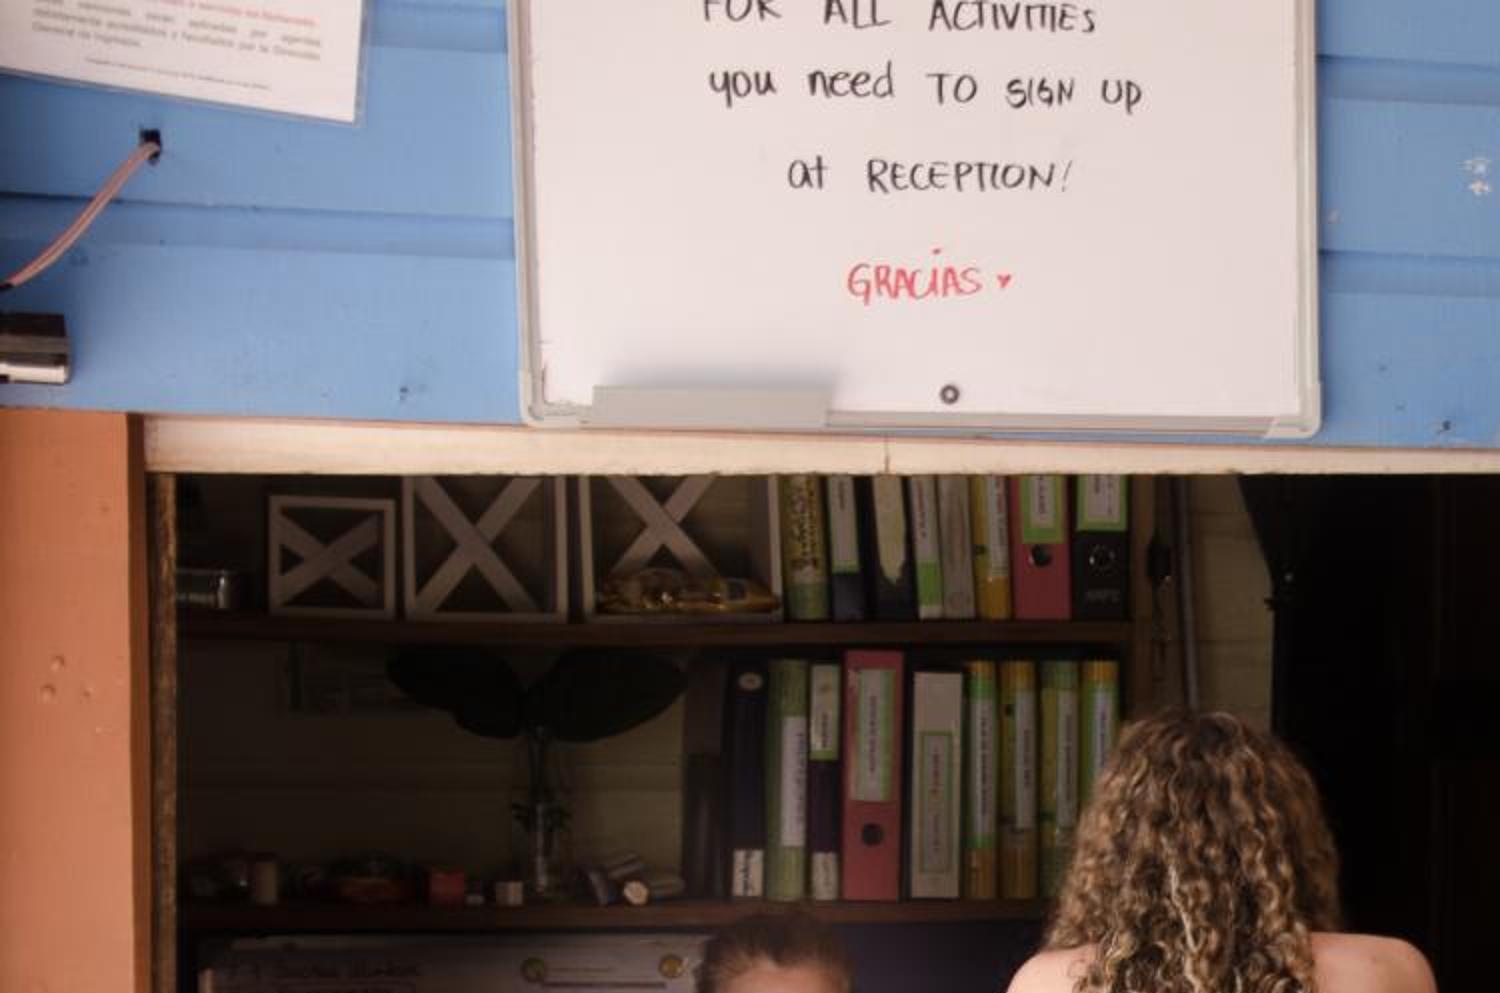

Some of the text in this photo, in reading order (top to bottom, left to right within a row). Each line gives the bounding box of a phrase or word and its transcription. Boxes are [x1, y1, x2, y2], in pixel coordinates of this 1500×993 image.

[704, 0, 1097, 33] FOR ALL ACTIVITIES
[708, 68, 777, 107] you
[807, 60, 895, 99] need
[926, 71, 979, 105] TO
[1005, 77, 1075, 108] SIGN
[786, 155, 1074, 195] at RECEPTION!
